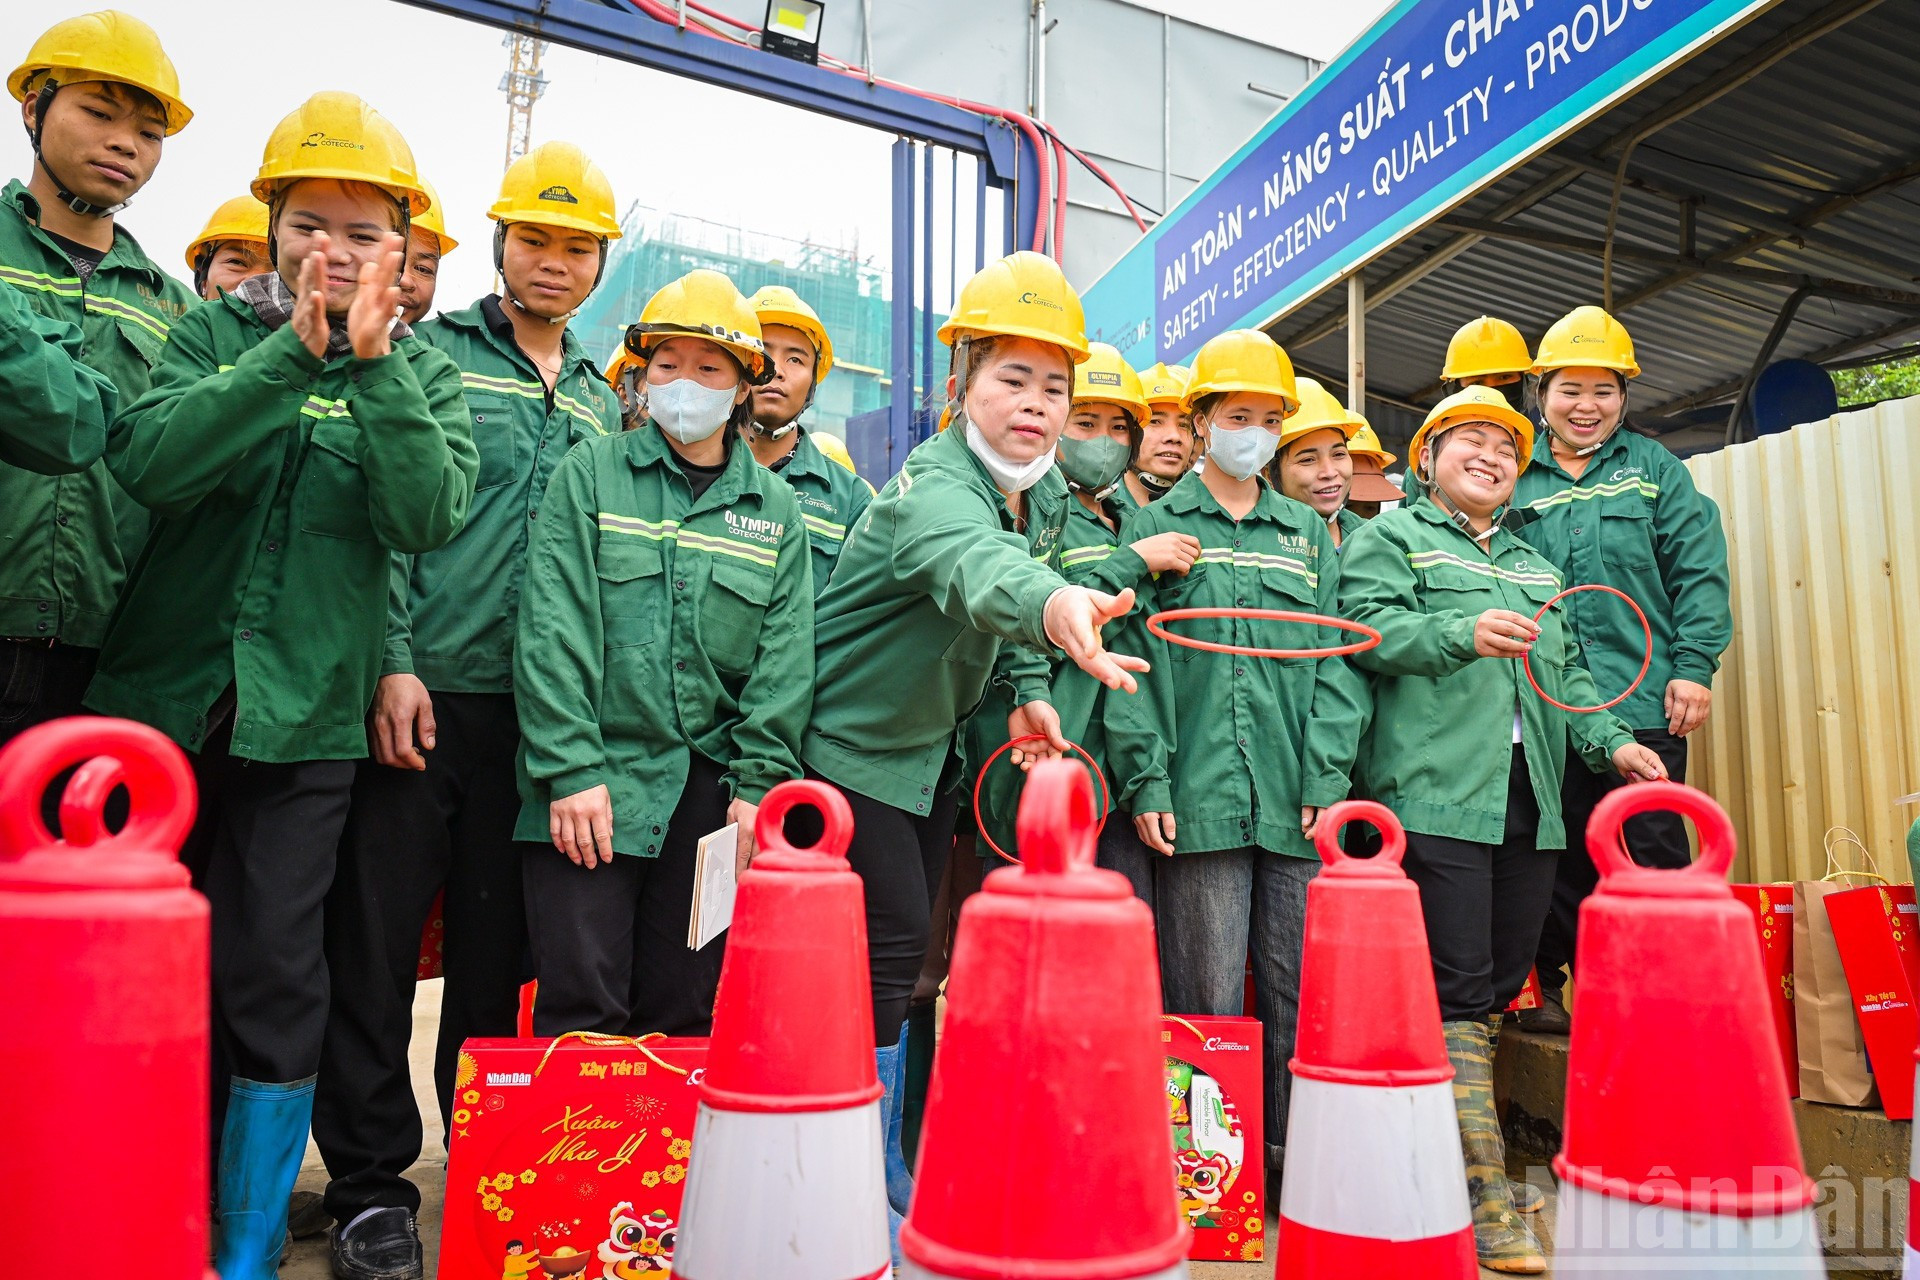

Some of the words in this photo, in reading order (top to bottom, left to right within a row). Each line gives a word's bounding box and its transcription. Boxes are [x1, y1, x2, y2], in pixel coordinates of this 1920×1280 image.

[1163, 283, 1219, 350] SAFETY
[1233, 182, 1350, 299] EFFICIENCY
[1372, 75, 1493, 196] QUALITY
[1526, 0, 1652, 90] PROD
[1163, 253, 1187, 300] AN
[1191, 204, 1242, 275] TOÀN
[1263, 130, 1331, 217] NĂNG
[1339, 57, 1410, 155] SUẤT
[725, 510, 784, 537] OLYMPIA
[728, 526, 778, 544] COTECCONS
[579, 1061, 608, 1079] Xây
[611, 1060, 633, 1076] Tết
[1203, 1088, 1211, 1117] Vegetable
[541, 1104, 623, 1134] Xuân
[536, 1131, 599, 1165] Như
[597, 1128, 647, 1173] Ý
